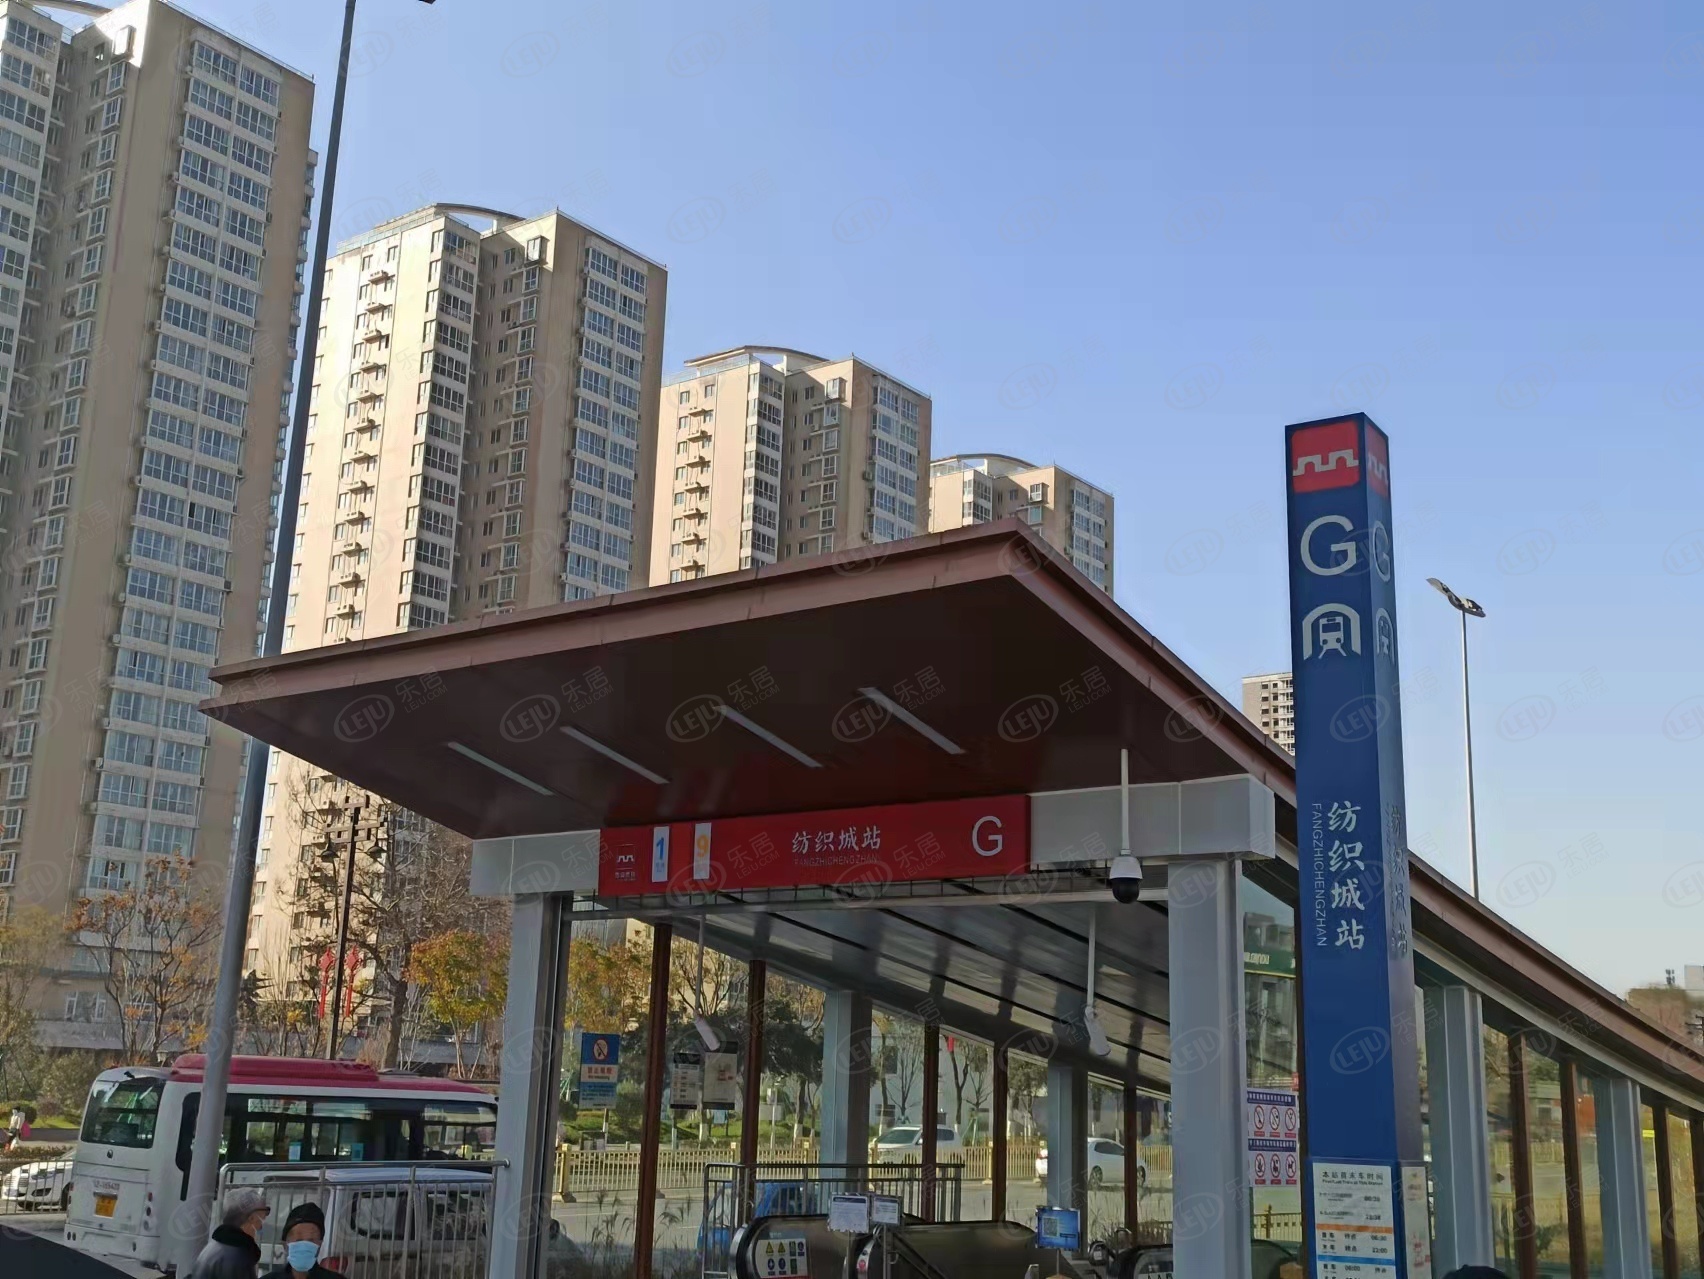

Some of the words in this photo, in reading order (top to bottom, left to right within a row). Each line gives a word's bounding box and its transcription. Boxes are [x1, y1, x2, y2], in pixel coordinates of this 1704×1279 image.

[1298, 514, 1359, 577] G
[1372, 520, 1392, 584] G
[656, 836, 664, 860] 1
[697, 834, 709, 858] 9
[791, 825, 882, 853] 纺织城站
[971, 815, 1004, 858] G
[1312, 802, 1327, 947] FANGZHICHENGZHAN
[1327, 799, 1366, 953] 纺织城站
